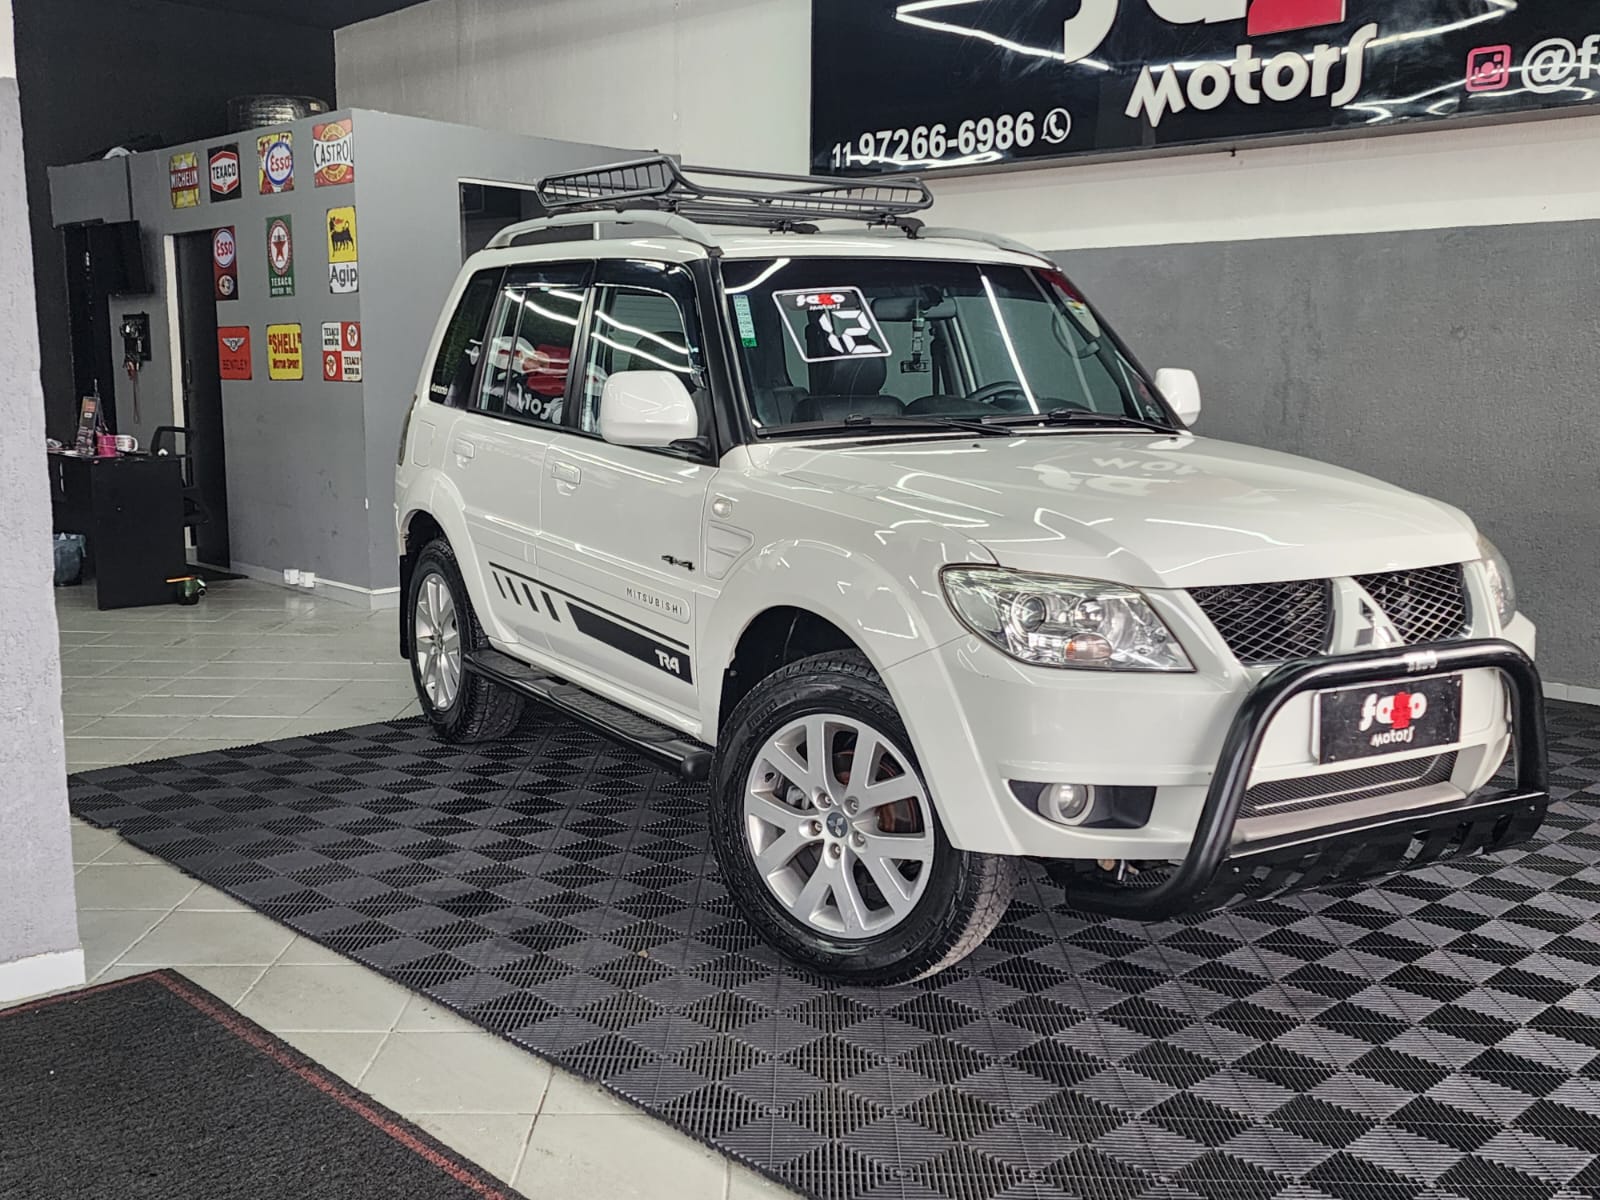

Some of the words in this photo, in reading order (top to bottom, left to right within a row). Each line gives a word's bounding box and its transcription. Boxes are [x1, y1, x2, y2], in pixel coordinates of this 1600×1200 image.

[1521, 34, 1600, 93] @f
[314, 136, 354, 168] CASTROL
[832, 142, 851, 168] 11
[859, 112, 1035, 165] 97266-6986
[171, 170, 198, 187] MICHELIN
[212, 163, 236, 180] TEXACO
[330, 264, 357, 287] Agip
[626, 587, 682, 616] MITSUBISHI
